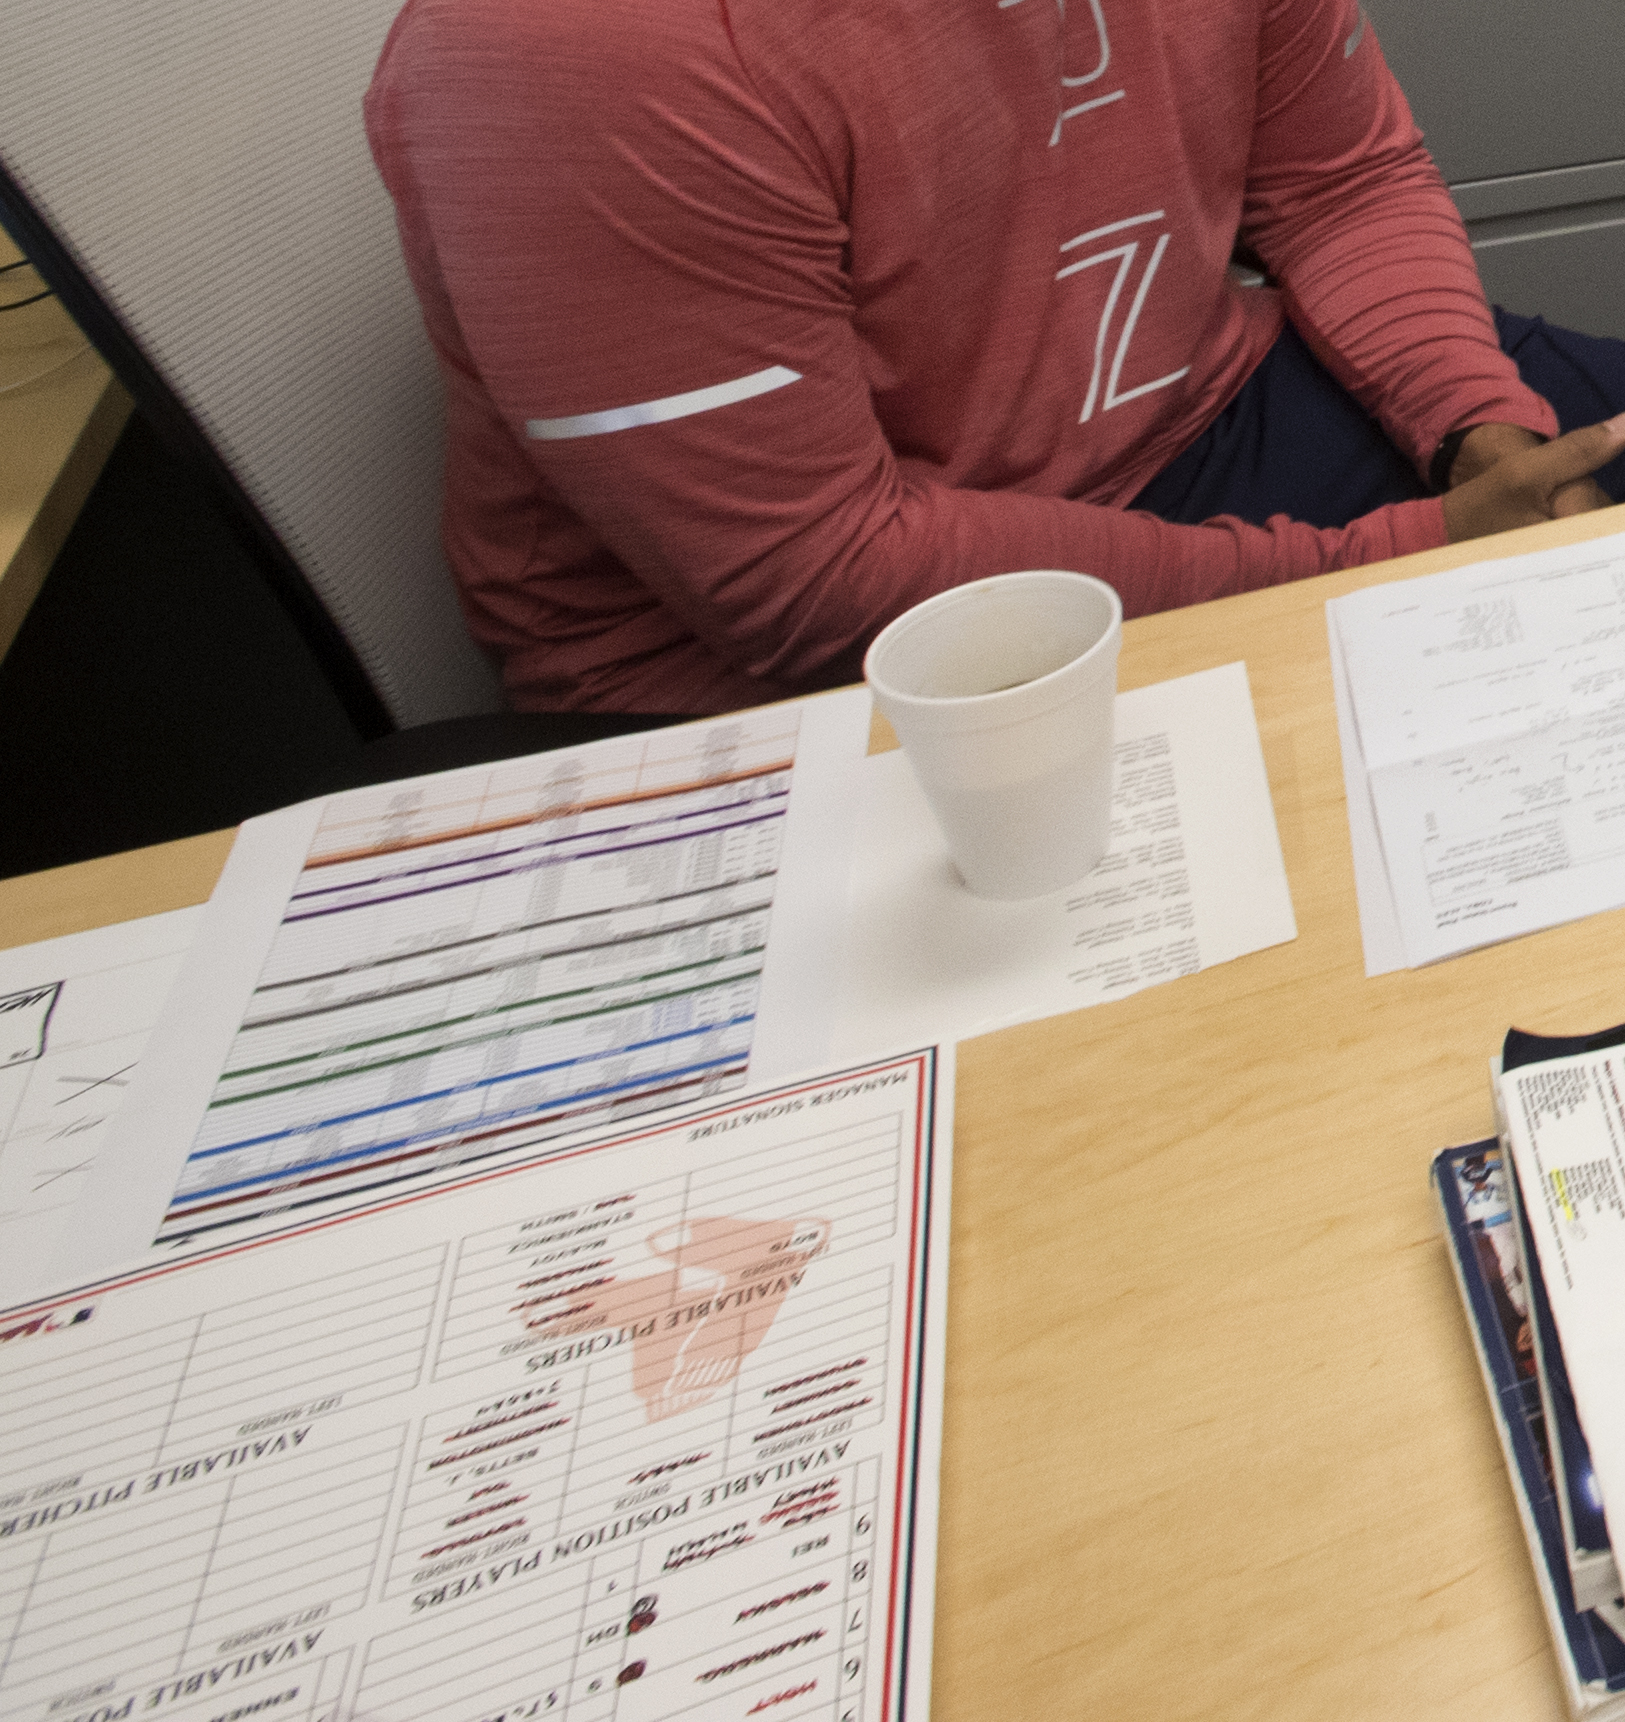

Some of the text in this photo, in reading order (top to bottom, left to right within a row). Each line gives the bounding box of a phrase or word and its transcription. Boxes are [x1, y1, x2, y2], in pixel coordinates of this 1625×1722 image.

[687, 1070, 908, 1144] MANAGER SIGNATURE
[525, 1269, 808, 1374] AVAILABLE PITCHERS
[410, 1438, 853, 1615] AVAILABLE POSITION PLAYERS
[853, 1514, 872, 1537] 9
[851, 1560, 870, 1583] 8
[847, 1608, 864, 1633] 7
[843, 1658, 862, 1684] 6
